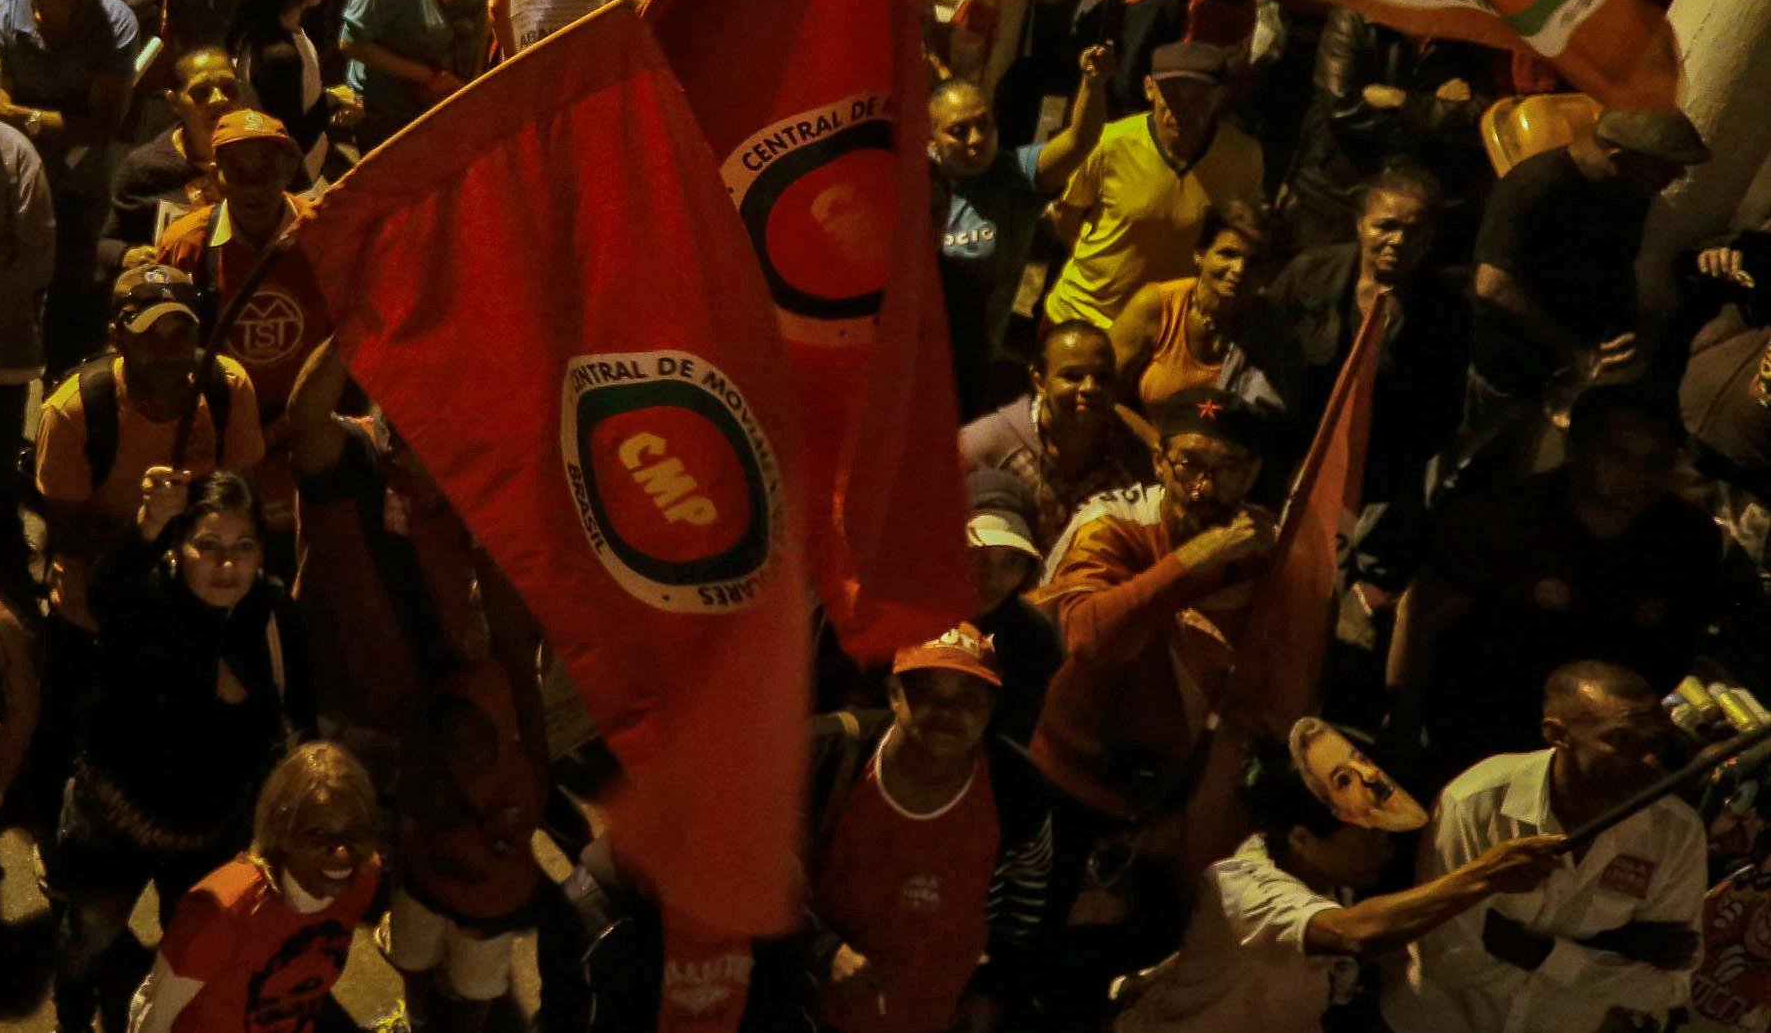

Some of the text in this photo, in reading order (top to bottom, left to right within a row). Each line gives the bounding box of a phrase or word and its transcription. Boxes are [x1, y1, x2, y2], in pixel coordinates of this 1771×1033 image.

[742, 96, 878, 172] CENTRAL DE
[657, 357, 694, 378] DE
[567, 463, 604, 554] BRASIL
[618, 431, 718, 526] CMP
